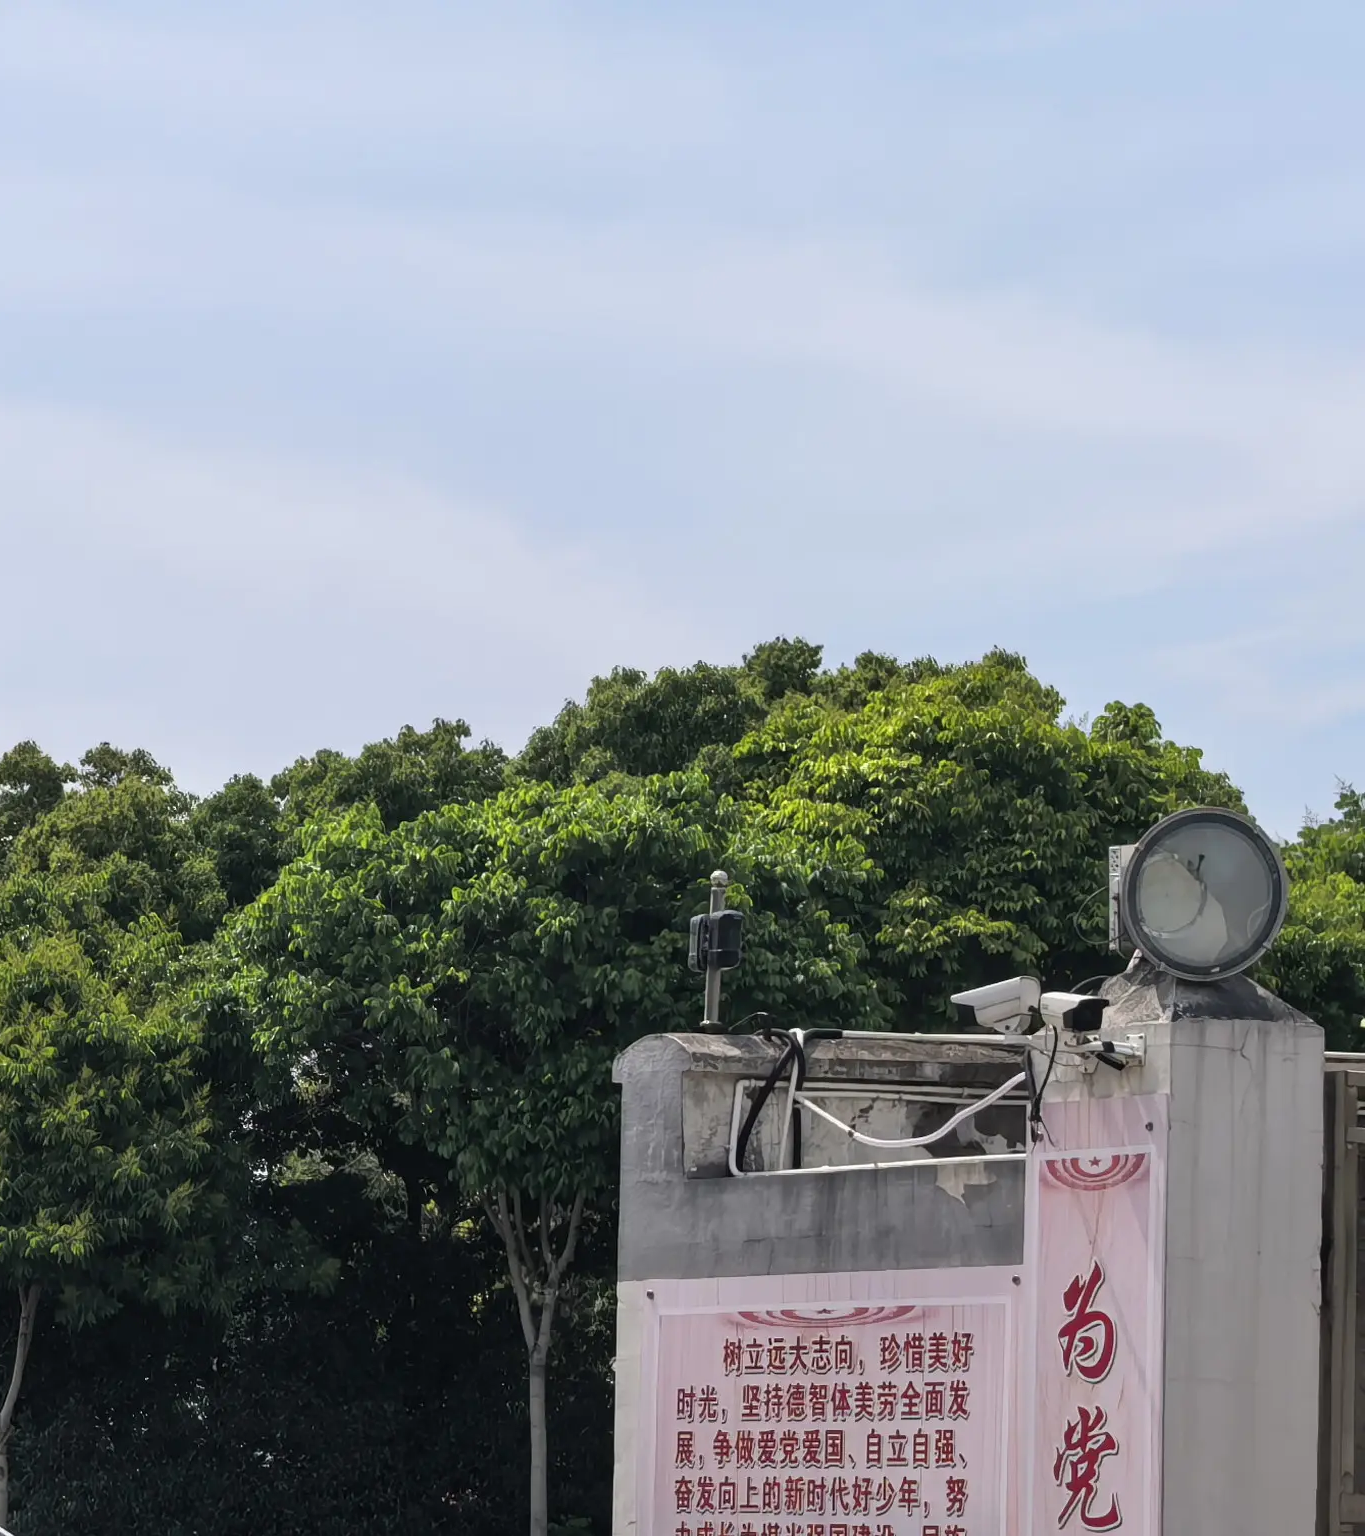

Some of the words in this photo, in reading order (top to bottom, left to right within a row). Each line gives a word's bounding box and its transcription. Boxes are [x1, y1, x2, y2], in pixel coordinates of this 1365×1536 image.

[722, 1332, 974, 1375] 树立远大志向，珍惜美好
[675, 1380, 970, 1422] 时光，坚持德智体美劳全面发
[674, 1429, 969, 1469] 展，争做爱党爱国、自立自强、
[673, 1476, 969, 1516] 奋发向上的新时代好少年，努
